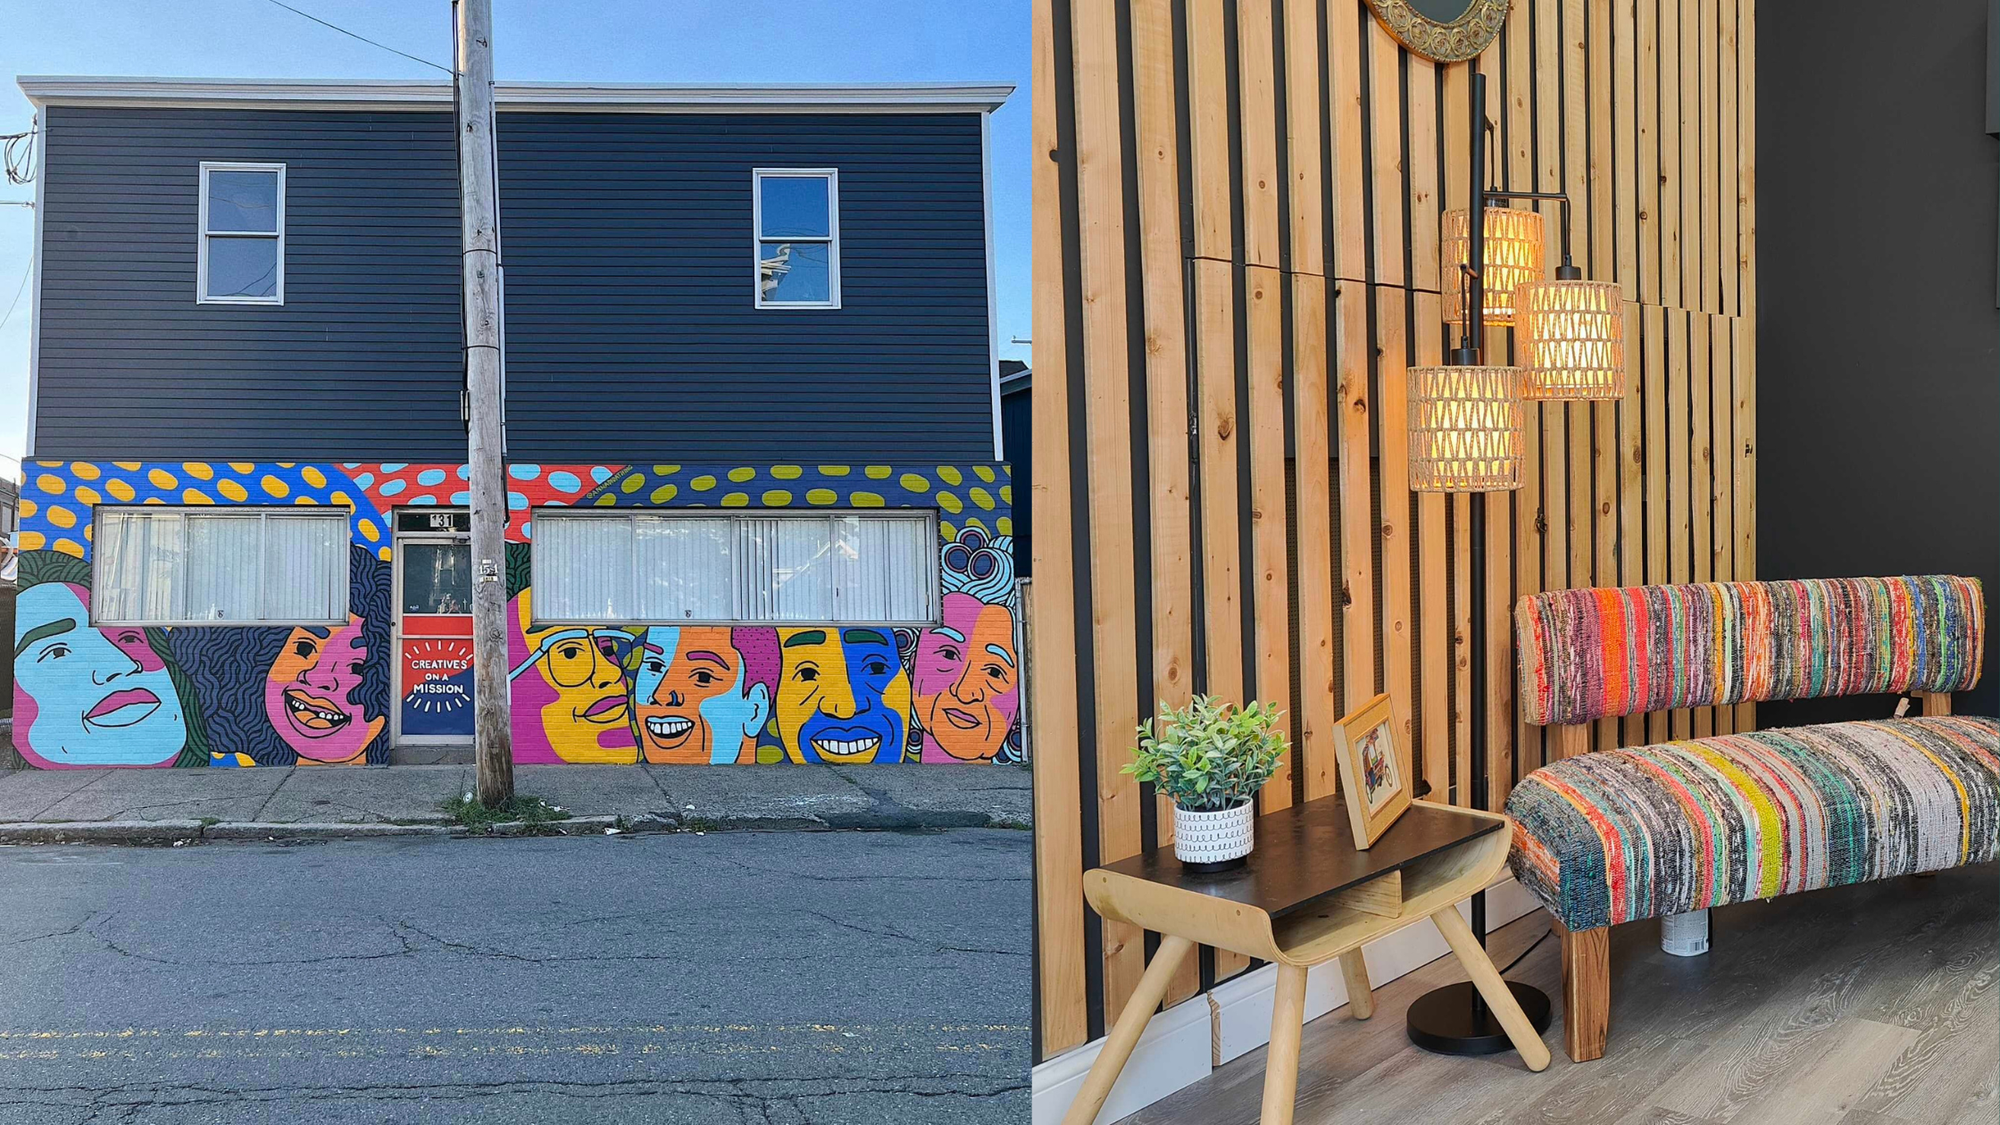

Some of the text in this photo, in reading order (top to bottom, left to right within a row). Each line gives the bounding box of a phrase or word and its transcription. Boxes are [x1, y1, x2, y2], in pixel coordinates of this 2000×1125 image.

[432, 514, 452, 527] 131
[411, 660, 468, 669] CREATIVES
[425, 673, 449, 681] ON A
[413, 684, 463, 694] MISSION
